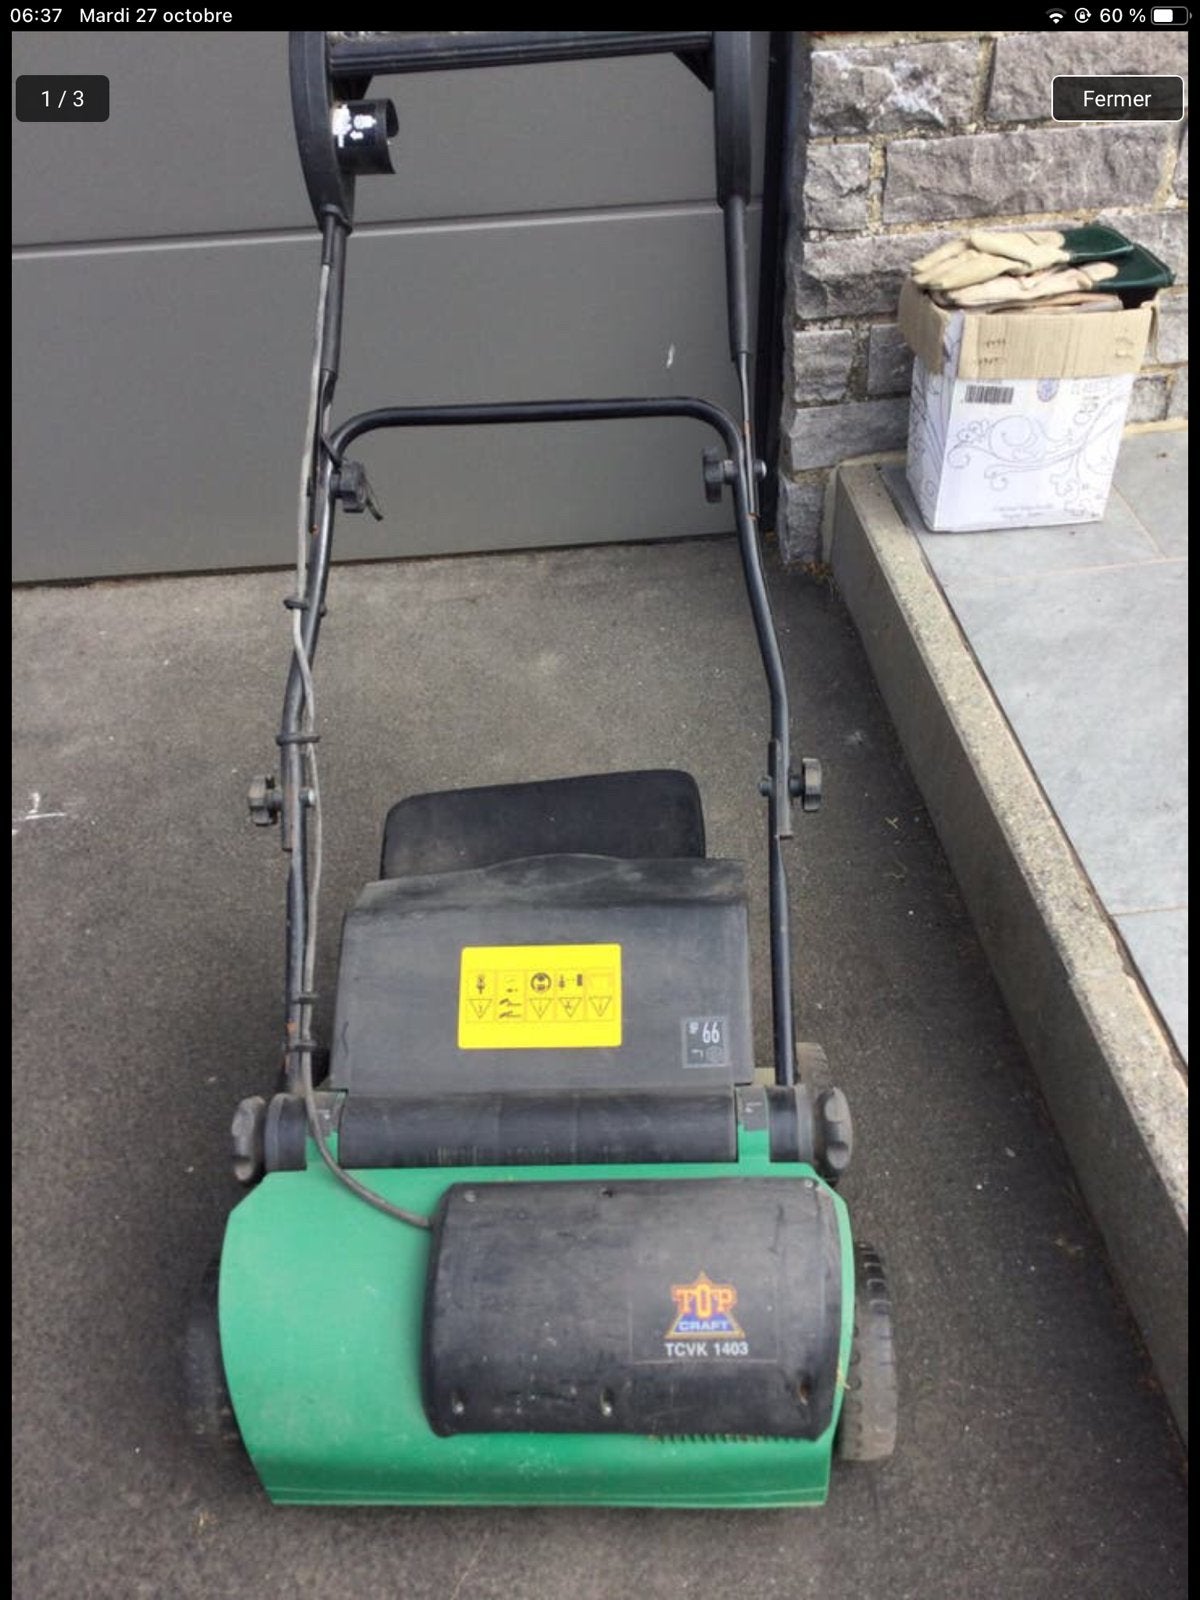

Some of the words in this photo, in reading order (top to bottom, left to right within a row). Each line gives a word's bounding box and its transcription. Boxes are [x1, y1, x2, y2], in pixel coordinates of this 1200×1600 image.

[671, 1284, 737, 1319] TOP
[678, 1321, 728, 1331] CRAFT
[664, 1342, 708, 1356] TCVK
[714, 1341, 749, 1356] 1403
